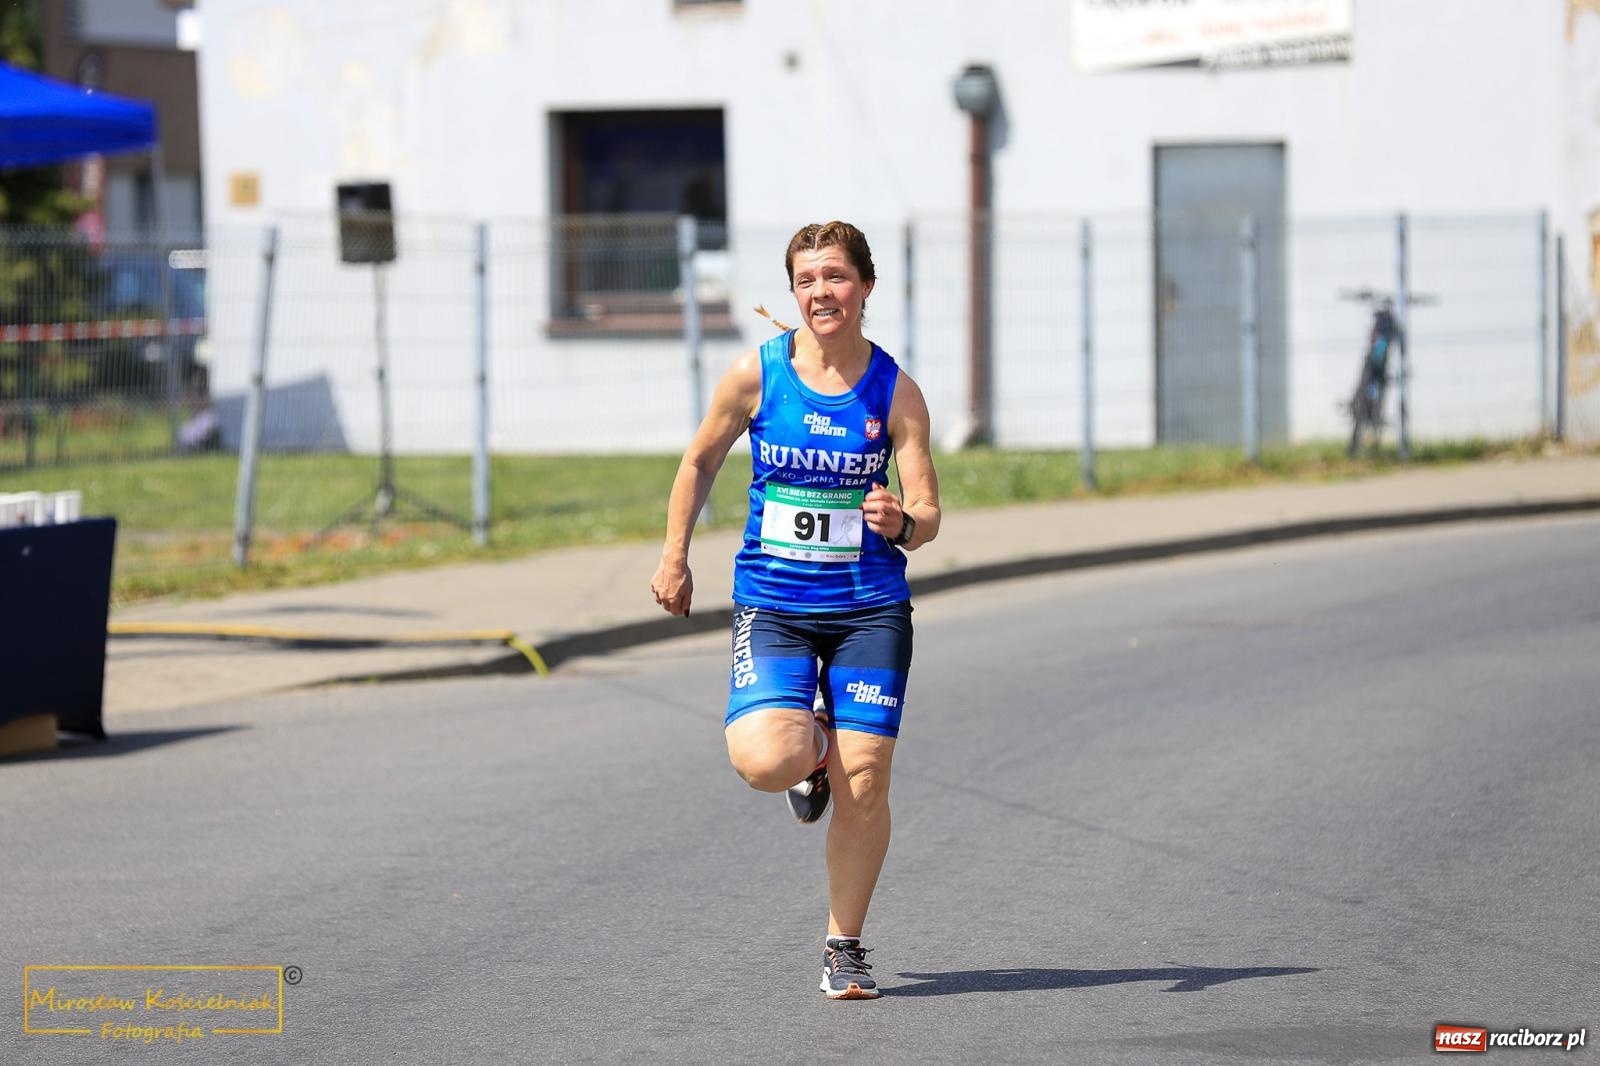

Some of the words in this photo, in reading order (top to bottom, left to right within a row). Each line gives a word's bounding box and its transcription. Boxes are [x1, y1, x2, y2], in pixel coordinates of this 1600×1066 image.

[760, 440, 886, 475] RUNNERS
[839, 477, 867, 486] TEAM
[794, 511, 831, 542] 91
[733, 606, 759, 688] UNNERS
